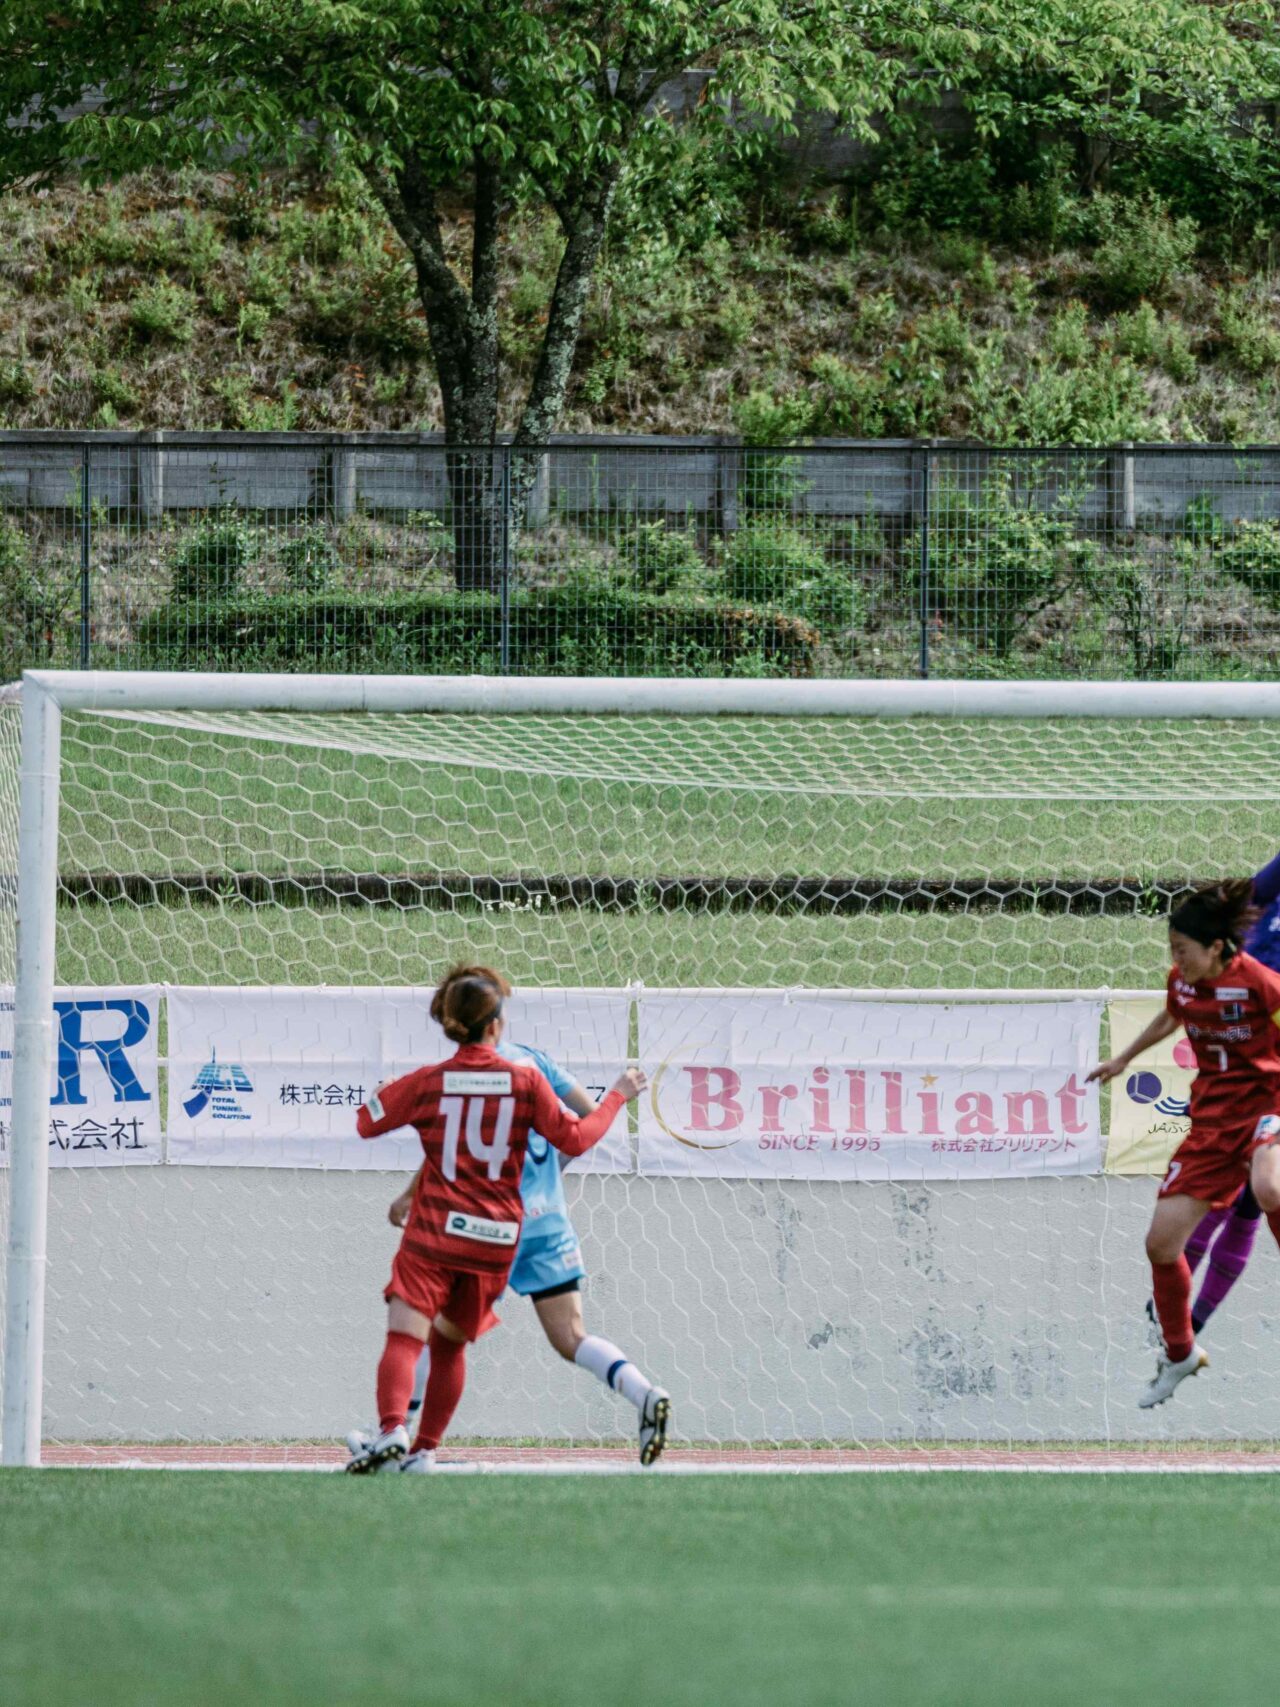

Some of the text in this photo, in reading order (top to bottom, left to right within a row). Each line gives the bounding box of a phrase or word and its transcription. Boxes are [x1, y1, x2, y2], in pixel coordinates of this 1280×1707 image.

[1206, 1045, 1229, 1072] 7
[280, 1083, 366, 1106] 株式会社
[683, 1065, 1088, 1135] Brilliant
[439, 1097, 515, 1182] 14
[758, 1134, 881, 1152] SINCE 1995
[1161, 1161, 1182, 1192] 7
